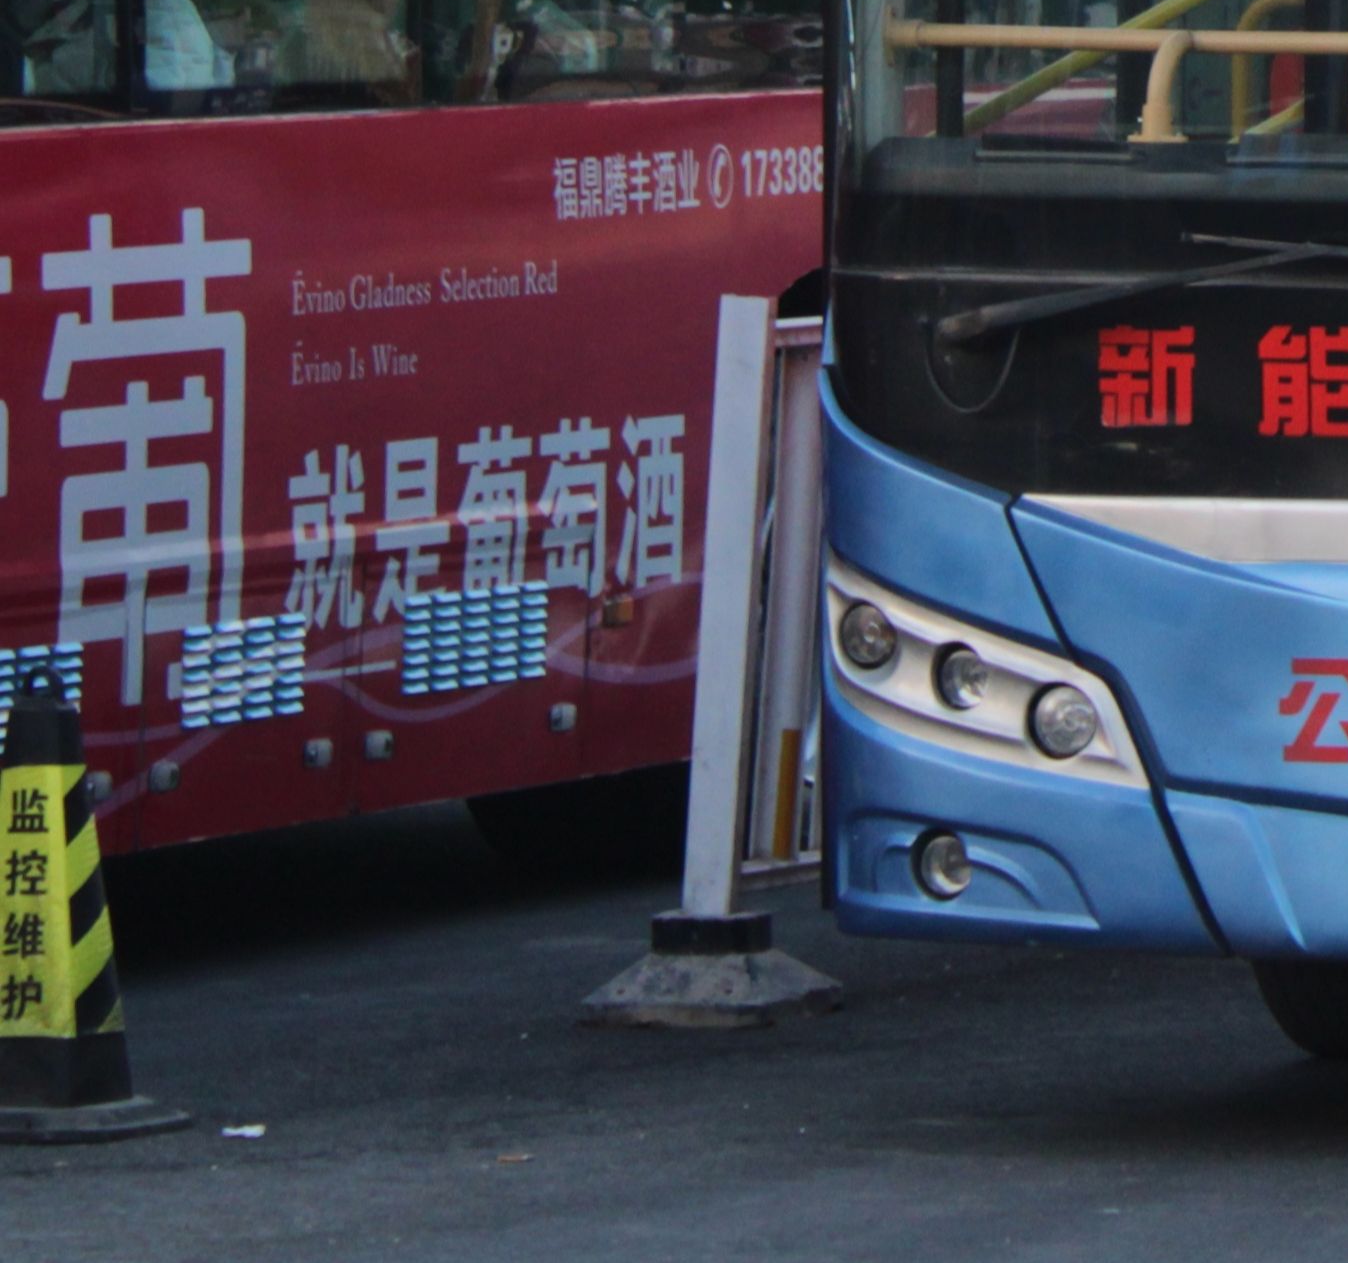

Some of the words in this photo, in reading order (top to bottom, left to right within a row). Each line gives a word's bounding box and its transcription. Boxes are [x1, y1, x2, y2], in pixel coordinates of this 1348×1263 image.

[553, 149, 701, 221] 福鼎腾丰酒业
[741, 145, 823, 197] 173388
[350, 272, 432, 312] Gladness
[440, 266, 520, 304] Selection
[525, 259, 558, 296] Red
[349, 346, 366, 381] Is
[372, 343, 419, 377] Wine
[284, 414, 687, 631] 就是葡萄酒
[1, 789, 49, 1021] 监控维护
